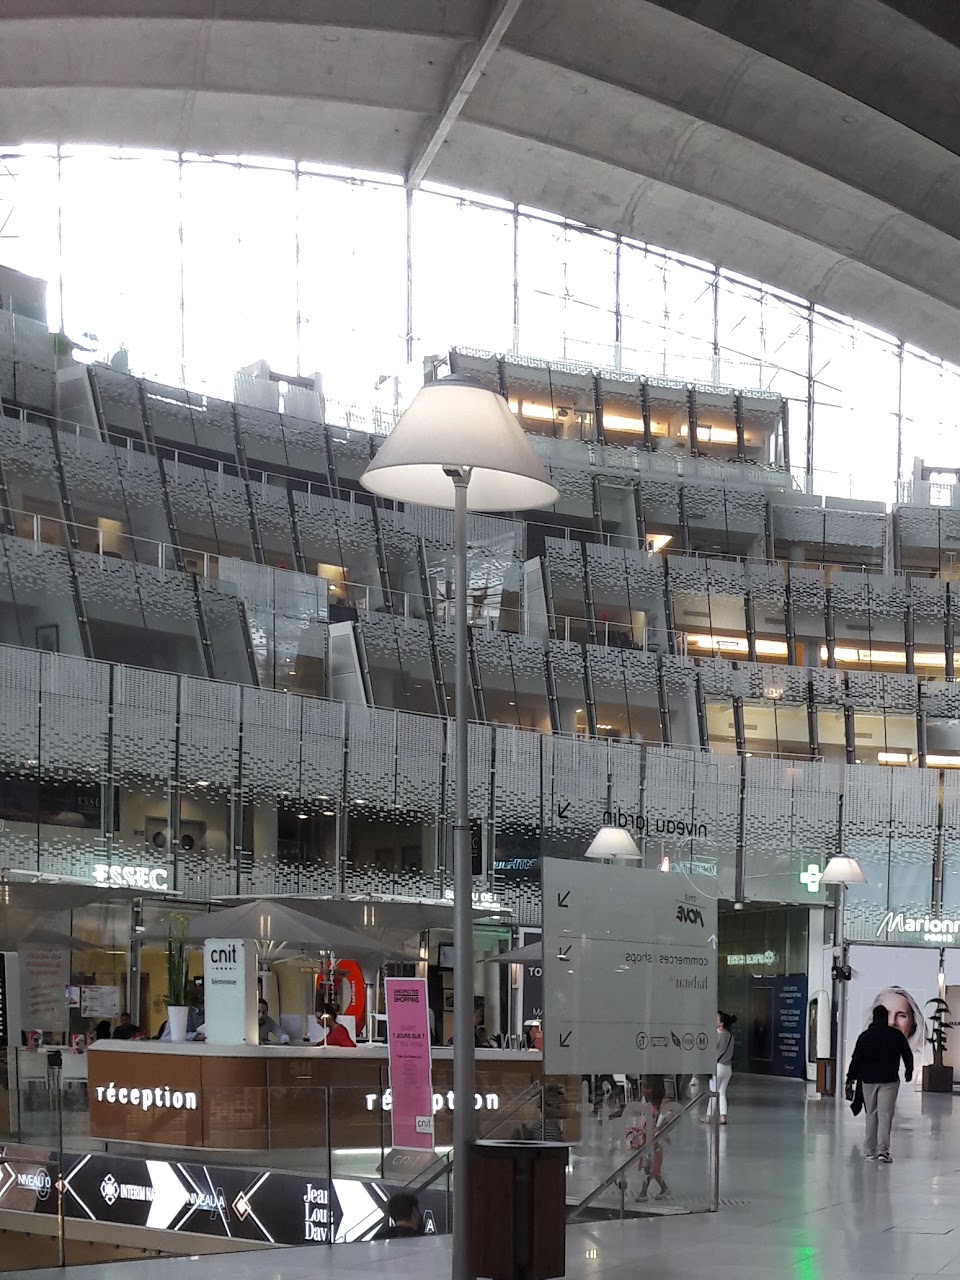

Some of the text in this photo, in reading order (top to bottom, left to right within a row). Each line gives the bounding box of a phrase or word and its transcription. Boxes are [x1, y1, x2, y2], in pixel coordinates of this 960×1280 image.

[92, 864, 168, 891] ESSEC
[924, 933, 953, 943] PARIS
[211, 944, 237, 964] cnit
[393, 996, 420, 1004] SHOPPING
[96, 1081, 197, 1111] réception
[365, 1088, 500, 1115] répton
[417, 1118, 431, 1128] cnit
[18, 1173, 44, 1188] NIVEAU
[304, 1202, 334, 1223] Lou
[304, 1221, 334, 1244] Davd
